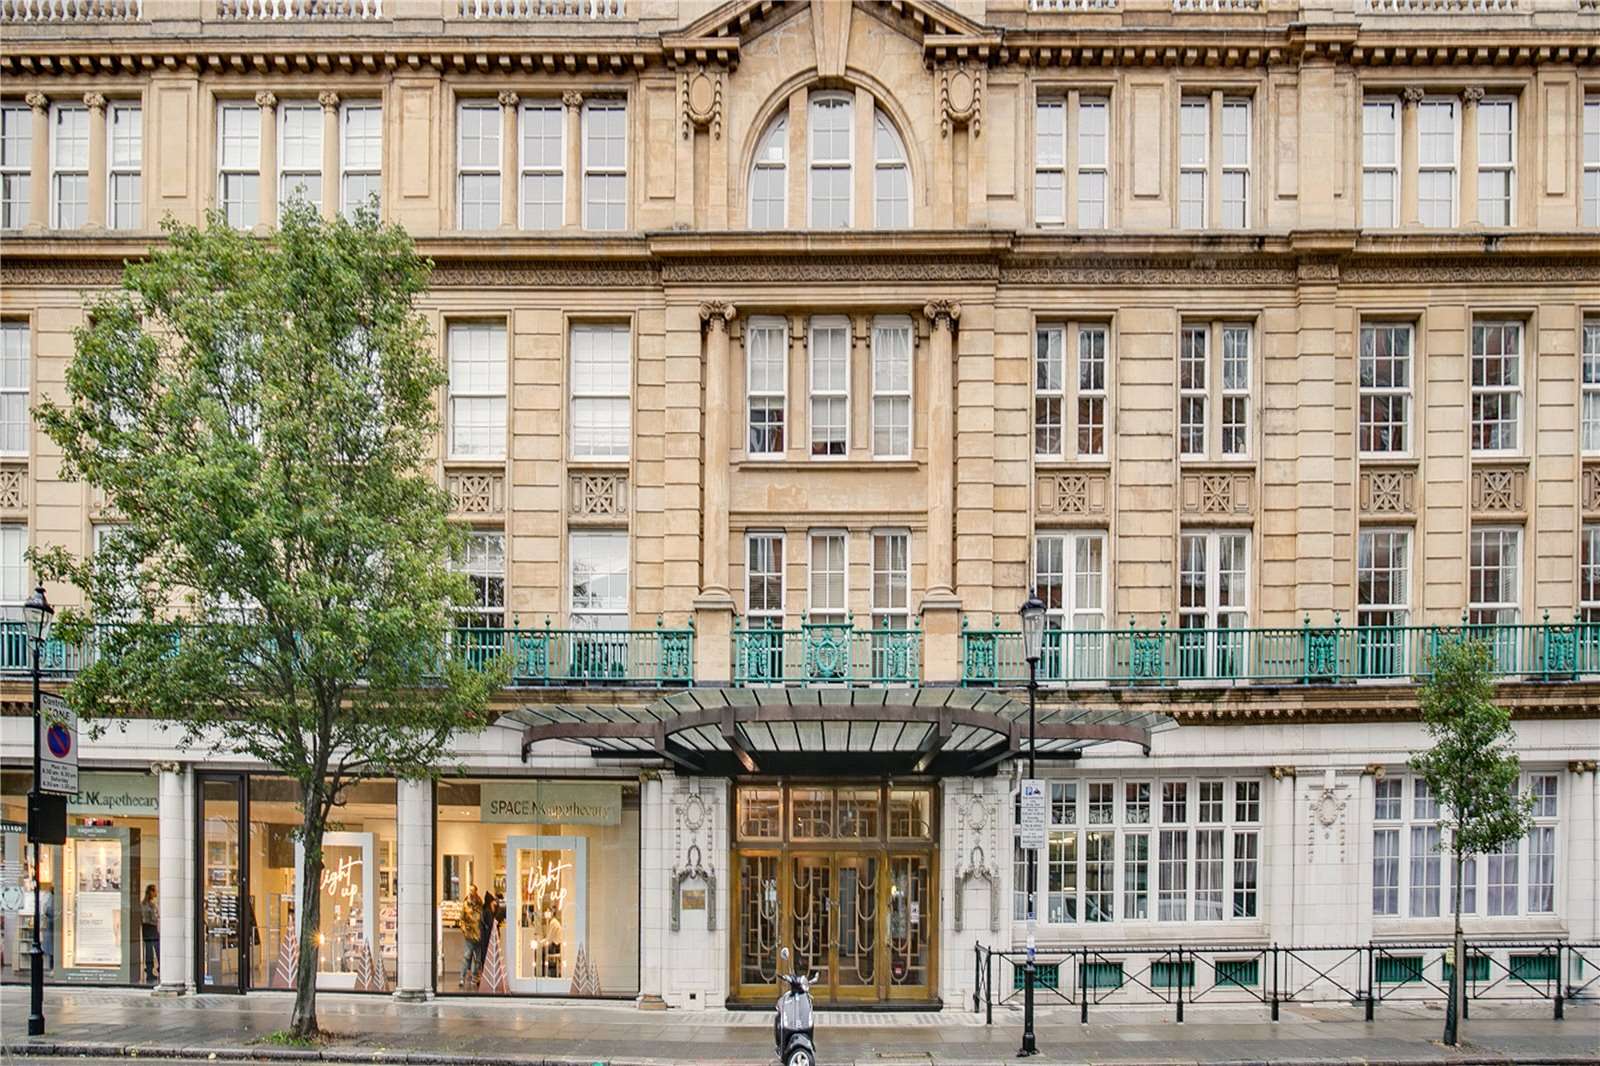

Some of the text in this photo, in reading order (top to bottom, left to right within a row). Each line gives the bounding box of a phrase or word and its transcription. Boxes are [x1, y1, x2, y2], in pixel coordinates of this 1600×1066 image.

[320, 855, 363, 896] light
[528, 860, 573, 900] light
[341, 884, 358, 907] up
[550, 888, 568, 911] up
